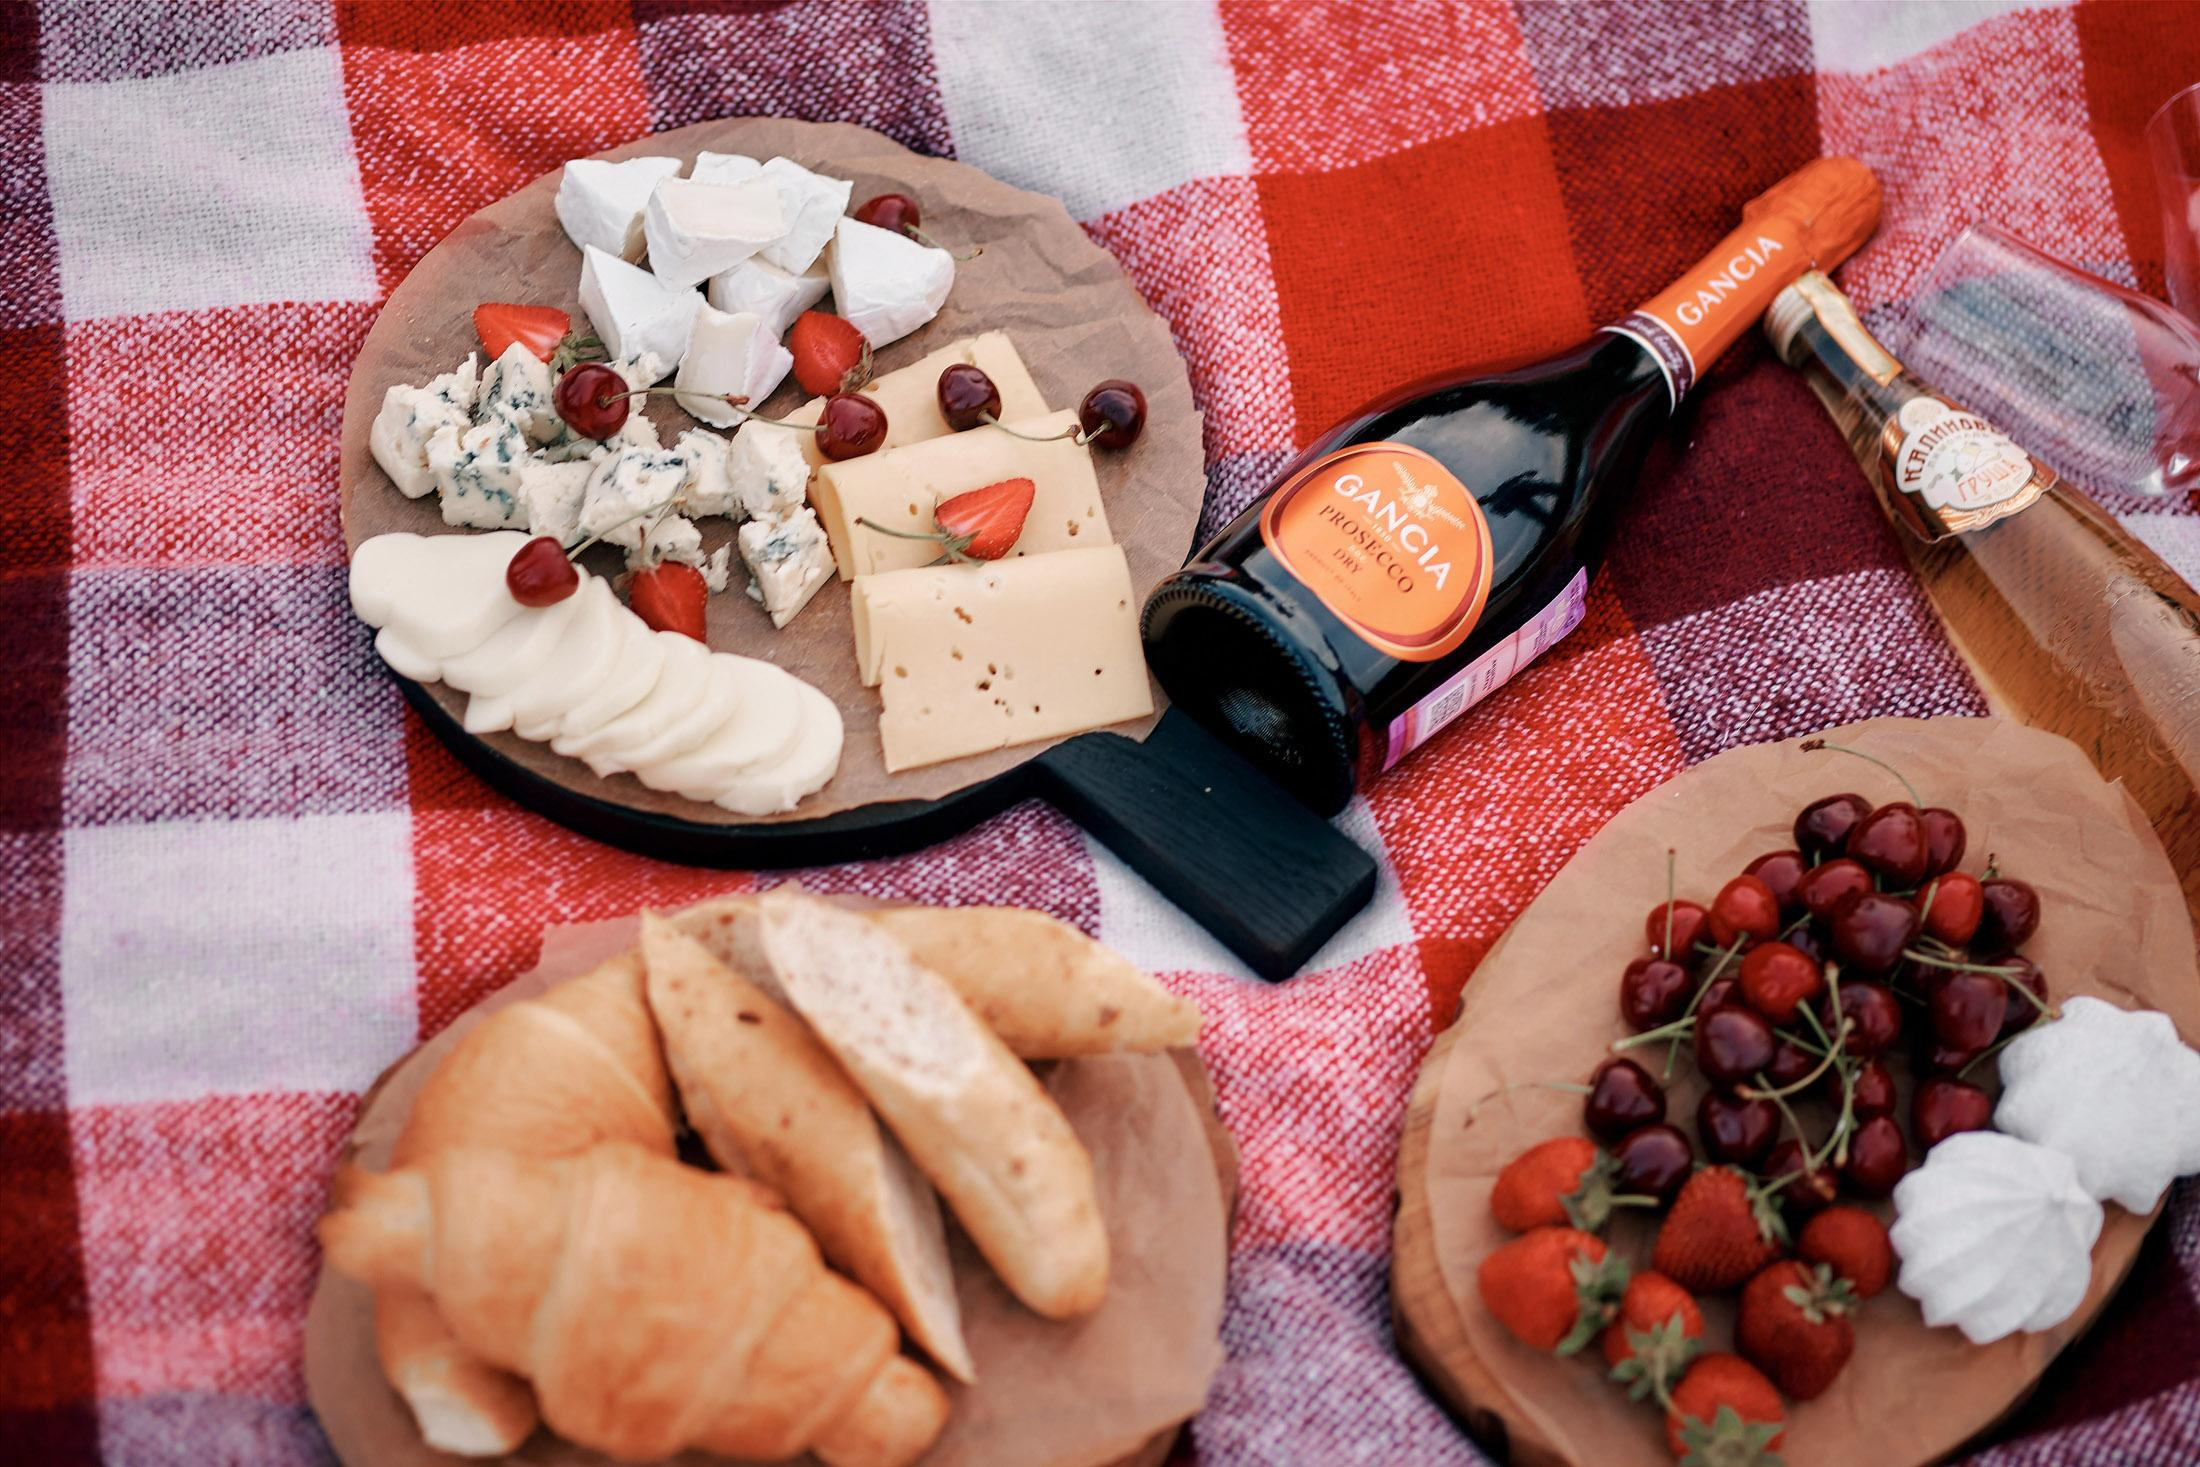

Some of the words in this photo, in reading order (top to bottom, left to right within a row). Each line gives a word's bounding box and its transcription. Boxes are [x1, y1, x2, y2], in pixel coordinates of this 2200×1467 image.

[1676, 236, 1783, 326] GANCIA
[1319, 504, 1414, 593] PROSECCO
[1333, 474, 1452, 592] GANCIA
[1333, 548, 1362, 575] DRY
